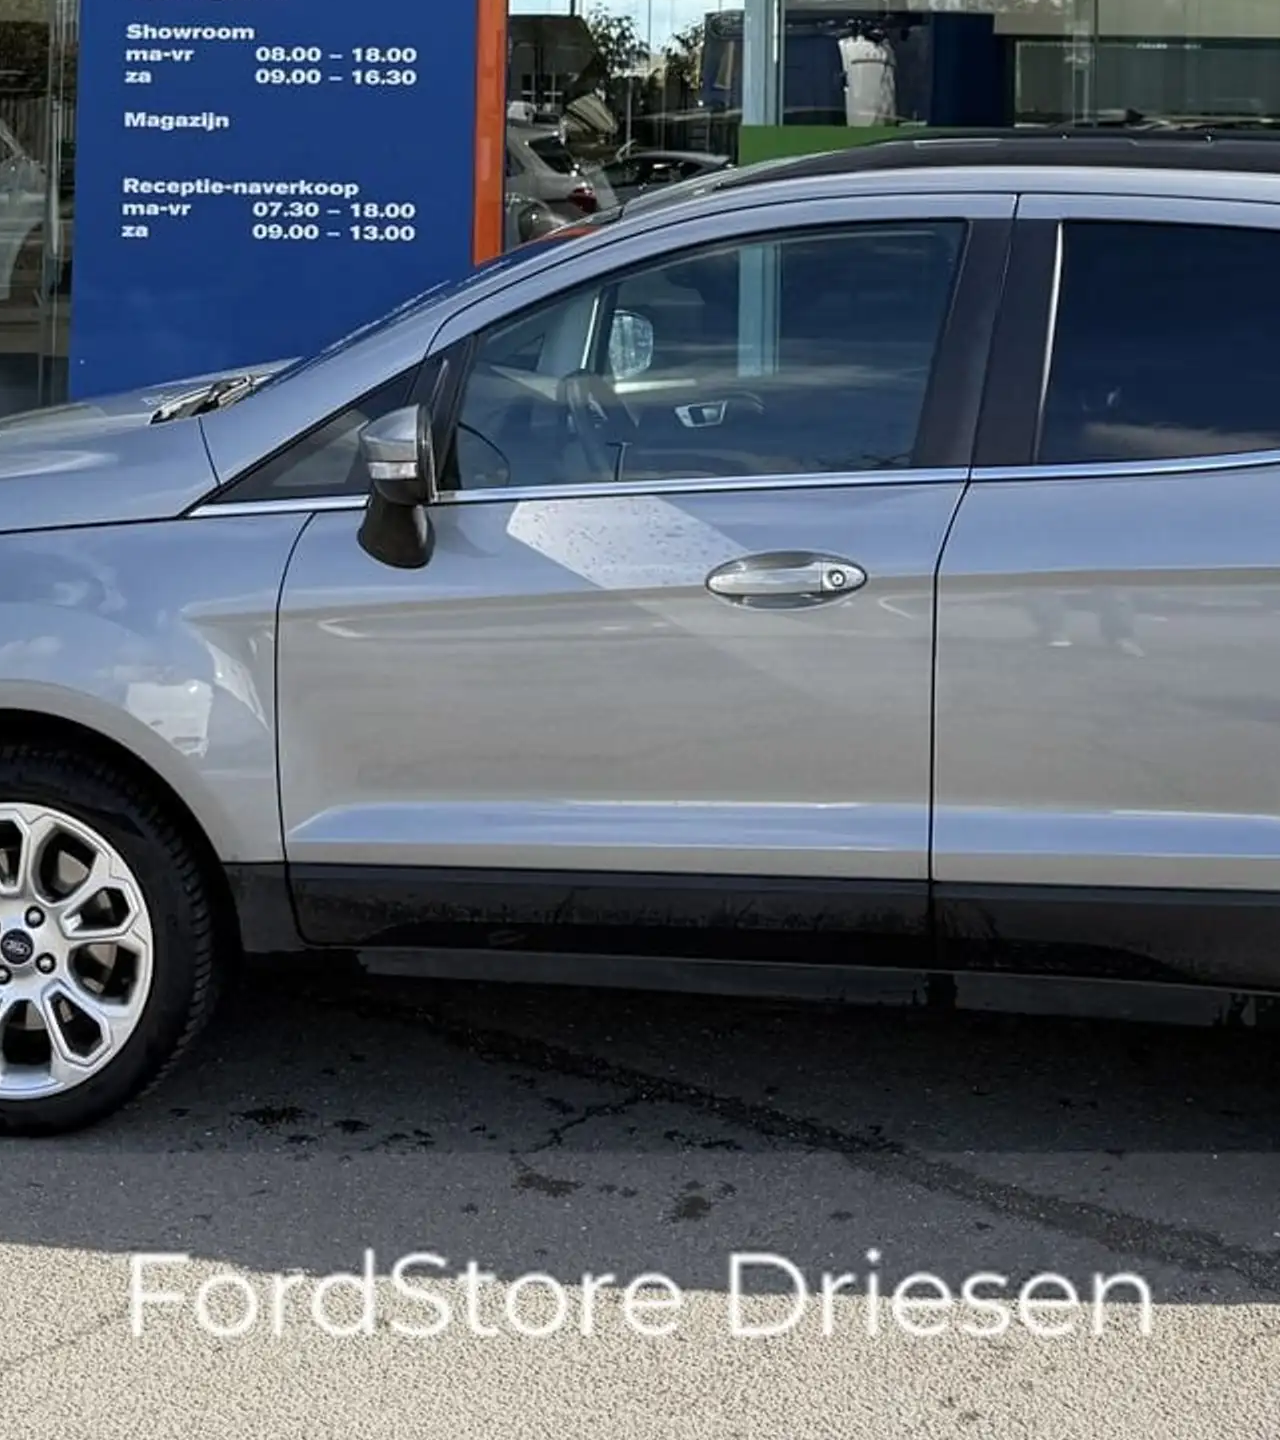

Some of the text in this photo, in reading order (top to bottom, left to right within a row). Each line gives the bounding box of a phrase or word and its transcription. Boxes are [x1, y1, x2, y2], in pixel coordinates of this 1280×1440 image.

[126, 24, 255, 40] Showroom
[125, 49, 195, 62] ma-vr
[255, 47, 322, 62] 08.00
[351, 47, 417, 63] 18.00
[124, 71, 152, 84] za
[255, 69, 322, 84] 09.00
[351, 70, 417, 85] 16.30
[124, 111, 230, 131] Magazijn
[123, 178, 360, 198] Receptie-naverkoop
[122, 203, 192, 216] ma-vr
[252, 202, 320, 217] 07.30
[350, 203, 416, 218] 18.00
[121, 225, 149, 238] za
[252, 224, 320, 239] 09.00
[350, 225, 416, 241] 13.00
